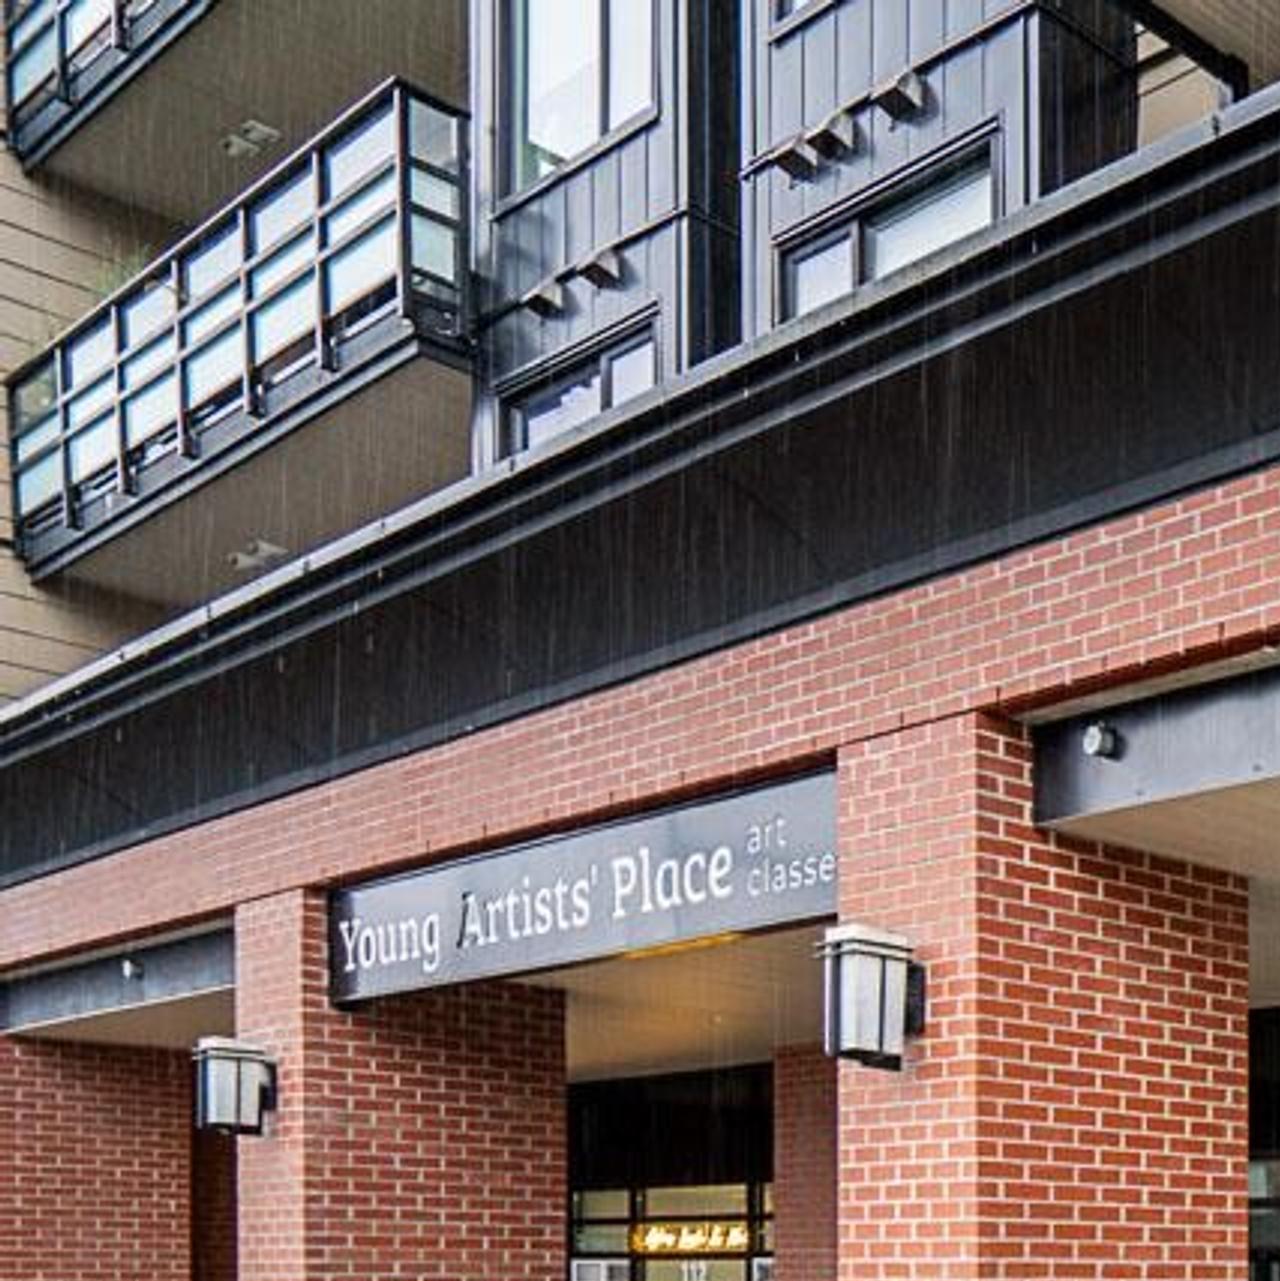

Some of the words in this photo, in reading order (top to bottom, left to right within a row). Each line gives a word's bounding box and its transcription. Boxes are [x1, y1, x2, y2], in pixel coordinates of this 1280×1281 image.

[746, 817, 787, 854] art
[746, 852, 835, 897] classe
[338, 912, 440, 973] Young
[457, 864, 598, 949] Artists'
[611, 845, 735, 919] Place
